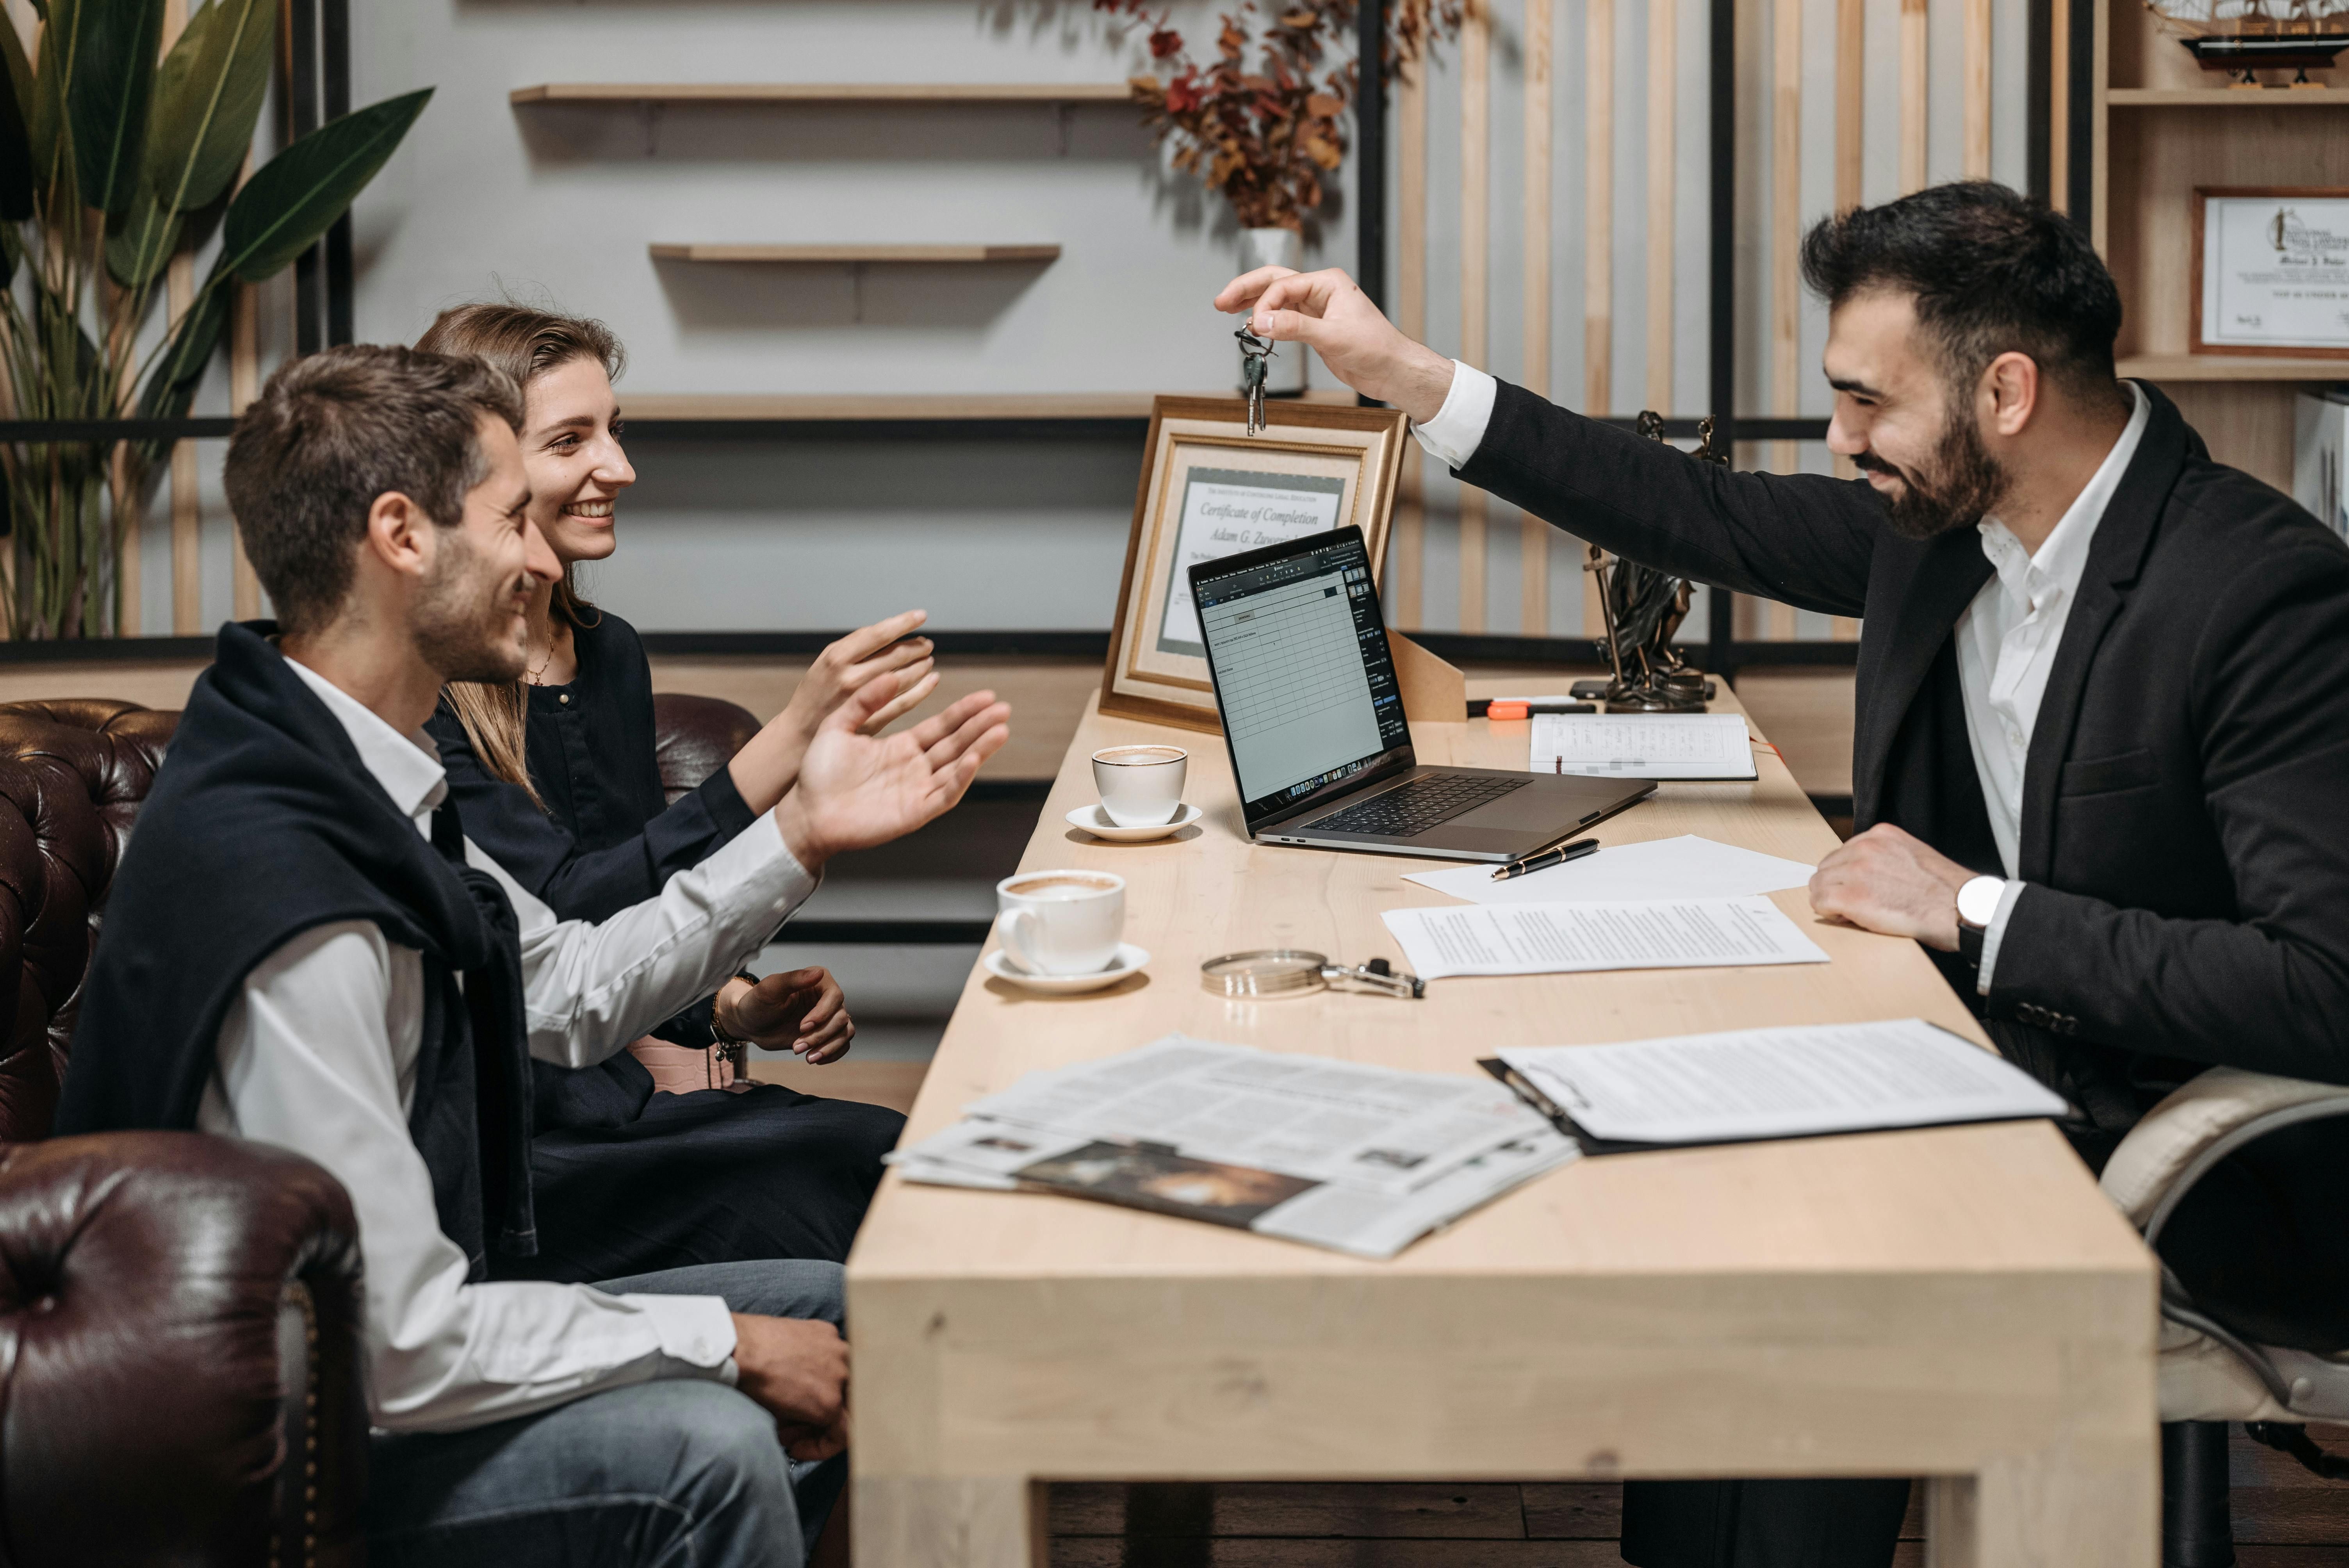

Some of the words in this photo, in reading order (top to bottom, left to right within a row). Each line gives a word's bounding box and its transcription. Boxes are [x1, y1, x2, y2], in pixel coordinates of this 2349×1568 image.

[1200, 502, 1249, 520] Certificate
[1250, 507, 1264, 523] of
[1263, 507, 1319, 526] Completion
[1210, 527, 1238, 542] Adam
[1240, 529, 1251, 543] G.
[1253, 531, 1298, 545] Zuweri
